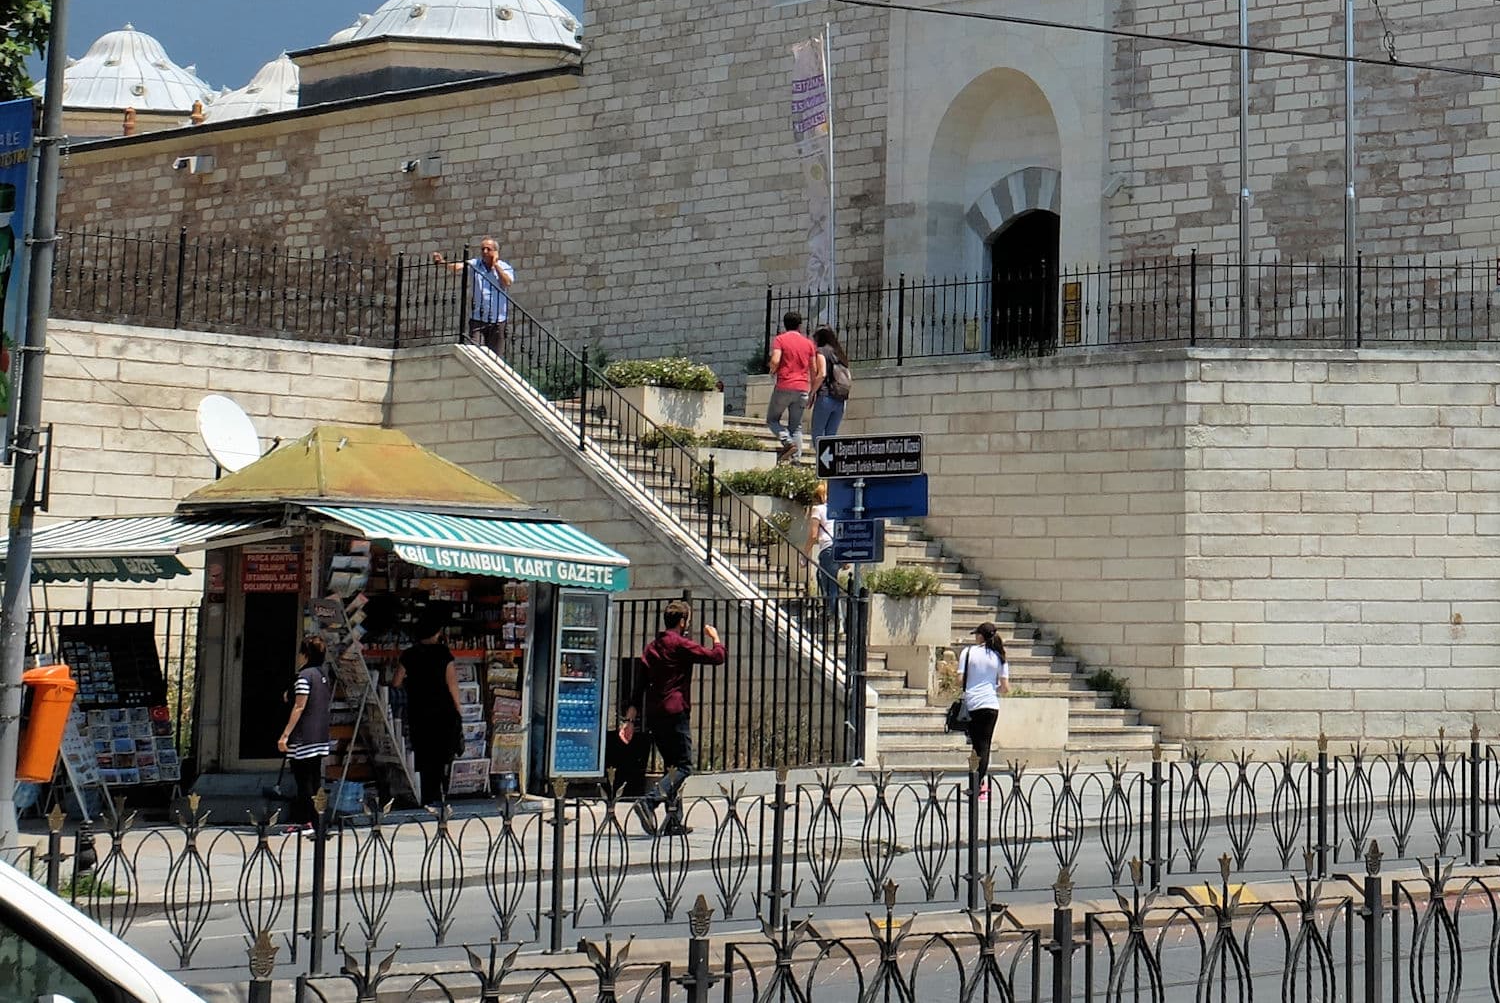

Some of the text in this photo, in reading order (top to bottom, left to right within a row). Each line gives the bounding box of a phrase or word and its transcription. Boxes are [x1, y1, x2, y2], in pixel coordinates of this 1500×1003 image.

[435, 546, 511, 574] İSTANBUL
[513, 557, 553, 577] KART
[556, 563, 613, 585] GAZETE
